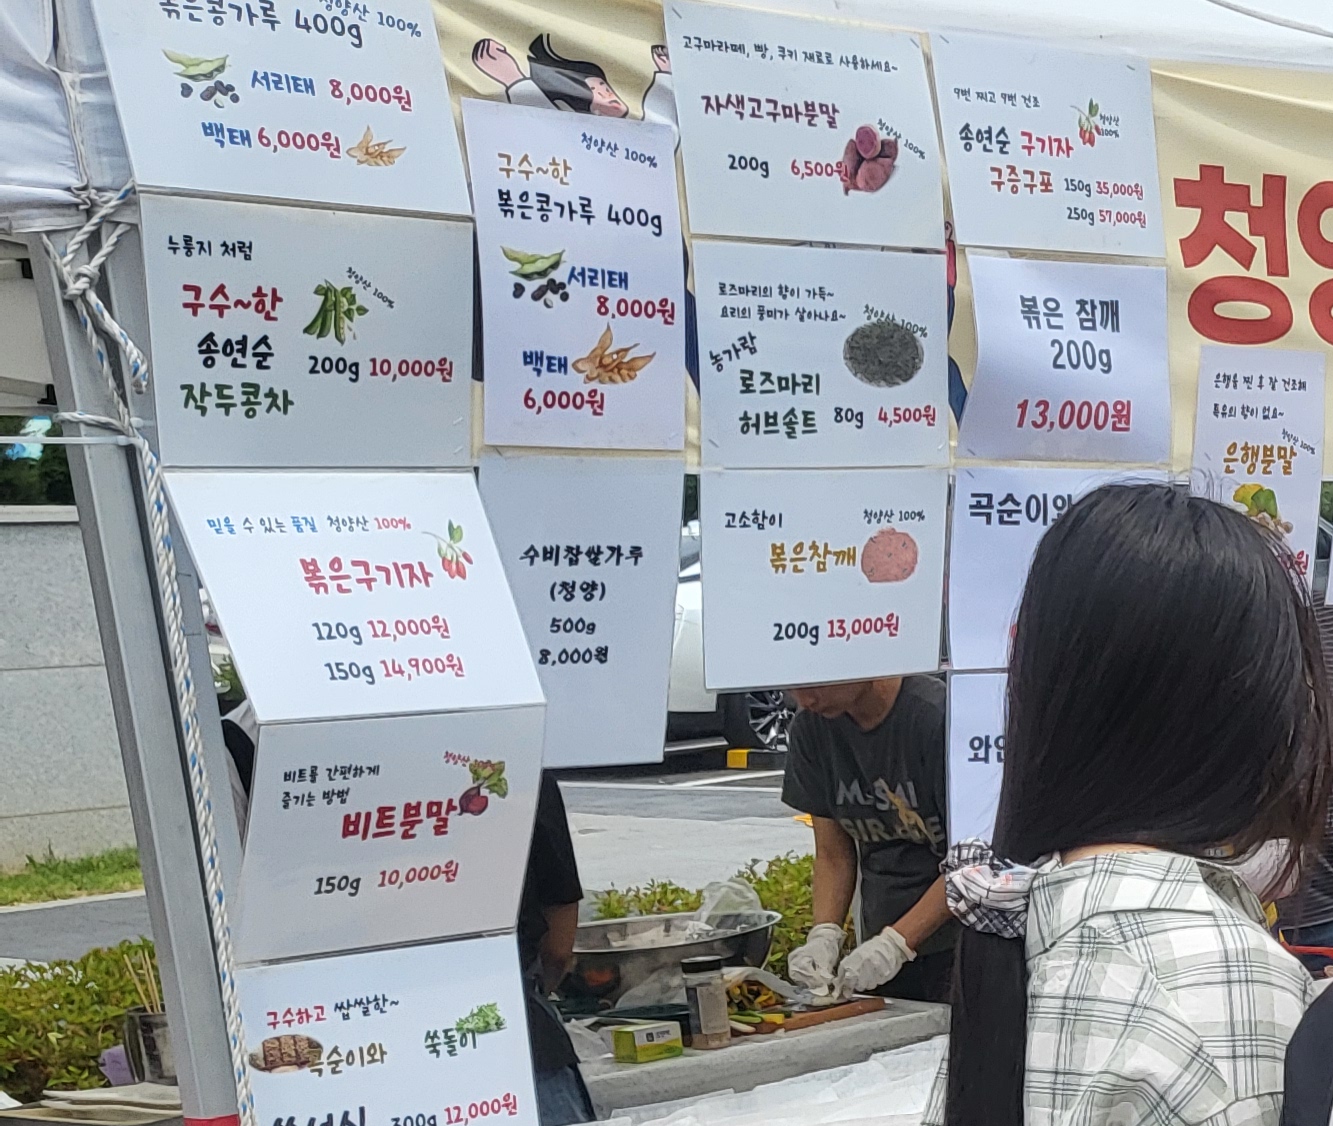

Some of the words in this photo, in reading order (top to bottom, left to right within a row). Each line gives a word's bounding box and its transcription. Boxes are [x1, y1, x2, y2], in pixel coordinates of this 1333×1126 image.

[295, 9, 366, 48] 400g
[377, 12, 421, 37] 100%
[683, 36, 749, 58] 고구마라떼,
[754, 44, 773, 60] 빵,
[778, 46, 797, 61] 쿠키
[802, 51, 834, 64] 재료로
[840, 55, 897, 72] 사용하세요~
[251, 70, 315, 96] 서리태
[329, 79, 412, 111] 8,000원
[954, 88, 971, 102] 9번
[975, 91, 996, 103] 찌고
[1001, 93, 1016, 106] 9번
[1021, 94, 1040, 108] 건조
[701, 93, 839, 128] 자색고구마분말
[201, 122, 252, 148] 백태
[258, 127, 341, 158] 6,000원
[582, 132, 619, 157] 청양산
[625, 148, 657, 168] 100%
[959, 123, 1010, 154] 송연순
[1021, 131, 1074, 158] 구기자
[498, 153, 572, 185] 구수~한
[728, 154, 769, 178] 200g
[790, 159, 848, 183] 6,500원
[990, 165, 1053, 194] 구증구포
[1064, 178, 1091, 197] 150g
[1096, 181, 1143, 200] 35,000원
[498, 189, 595, 225] 볶은콩가루
[608, 204, 662, 237] 400g
[1067, 207, 1094, 226] 250g
[1099, 210, 1146, 228] 57,000원
[168, 235, 211, 257] 누룽지
[220, 241, 252, 260] 처럼
[568, 266, 628, 290] 서리태
[719, 282, 772, 297] 로즈마리의
[778, 284, 799, 300] 향이
[805, 287, 834, 301] 가득~
[182, 283, 283, 321] 구수~한
[597, 295, 675, 325] 8,000원
[721, 305, 751, 318] 요리의
[757, 305, 789, 321] 풍미가
[795, 307, 846, 322] 살아나요~
[1020, 295, 1063, 330] 볶은
[1076, 299, 1120, 332] 참깨
[198, 332, 274, 370] 송연순
[523, 351, 567, 377] 백태
[709, 332, 757, 376] 농가람
[1051, 339, 1112, 374] 200g
[309, 356, 359, 383] 200g
[370, 357, 453, 382] 10,000원
[740, 369, 820, 395] 로즈마리
[1214, 373, 1238, 389] 은행을
[1243, 375, 1253, 389] 찐
[1257, 375, 1264, 389] 후
[180, 382, 294, 419] 작두콩차
[524, 388, 604, 416] 6,000원
[1017, 399, 1130, 432] 13,000원
[1213, 403, 1236, 418] 특유의
[1241, 404, 1258, 419] 향이
[739, 407, 817, 439] 허브솔트
[834, 407, 863, 429] 80g
[878, 405, 935, 427] 4,500원
[1223, 441, 1297, 475] 은행분말
[207, 517, 236, 534] 믿을
[243, 517, 254, 533] 수
[260, 517, 286, 533] 있는
[291, 516, 318, 533] 품질
[327, 515, 369, 532] 청양산
[374, 517, 411, 530] 100%
[725, 509, 782, 530] 고소함이
[864, 509, 894, 524] 청양산
[899, 510, 925, 521] 100%
[520, 545, 643, 566] 수비찹쌀가루
[769, 541, 857, 575] 볶은참깨
[300, 557, 433, 594] 볶은구기자
[550, 580, 605, 602] (청양)
[312, 623, 362, 645] 120g
[367, 615, 450, 642] 12,000원
[550, 618, 596, 634] 500g
[773, 622, 819, 646] 200g
[828, 613, 899, 641] 13,000원
[324, 662, 375, 685] 150g
[380, 654, 464, 681] 14,900원
[539, 646, 608, 666] 8,000원
[284, 766, 318, 783] 비트를
[326, 764, 379, 781] 간편하게
[282, 792, 315, 809] 즐기는
[323, 787, 350, 805] 방법
[341, 798, 457, 840] 비트분말
[314, 876, 361, 896] 150g
[378, 860, 459, 889] 10,000원
[267, 1006, 326, 1030] 구수하고
[444, 1093, 517, 1126] 12,000원
